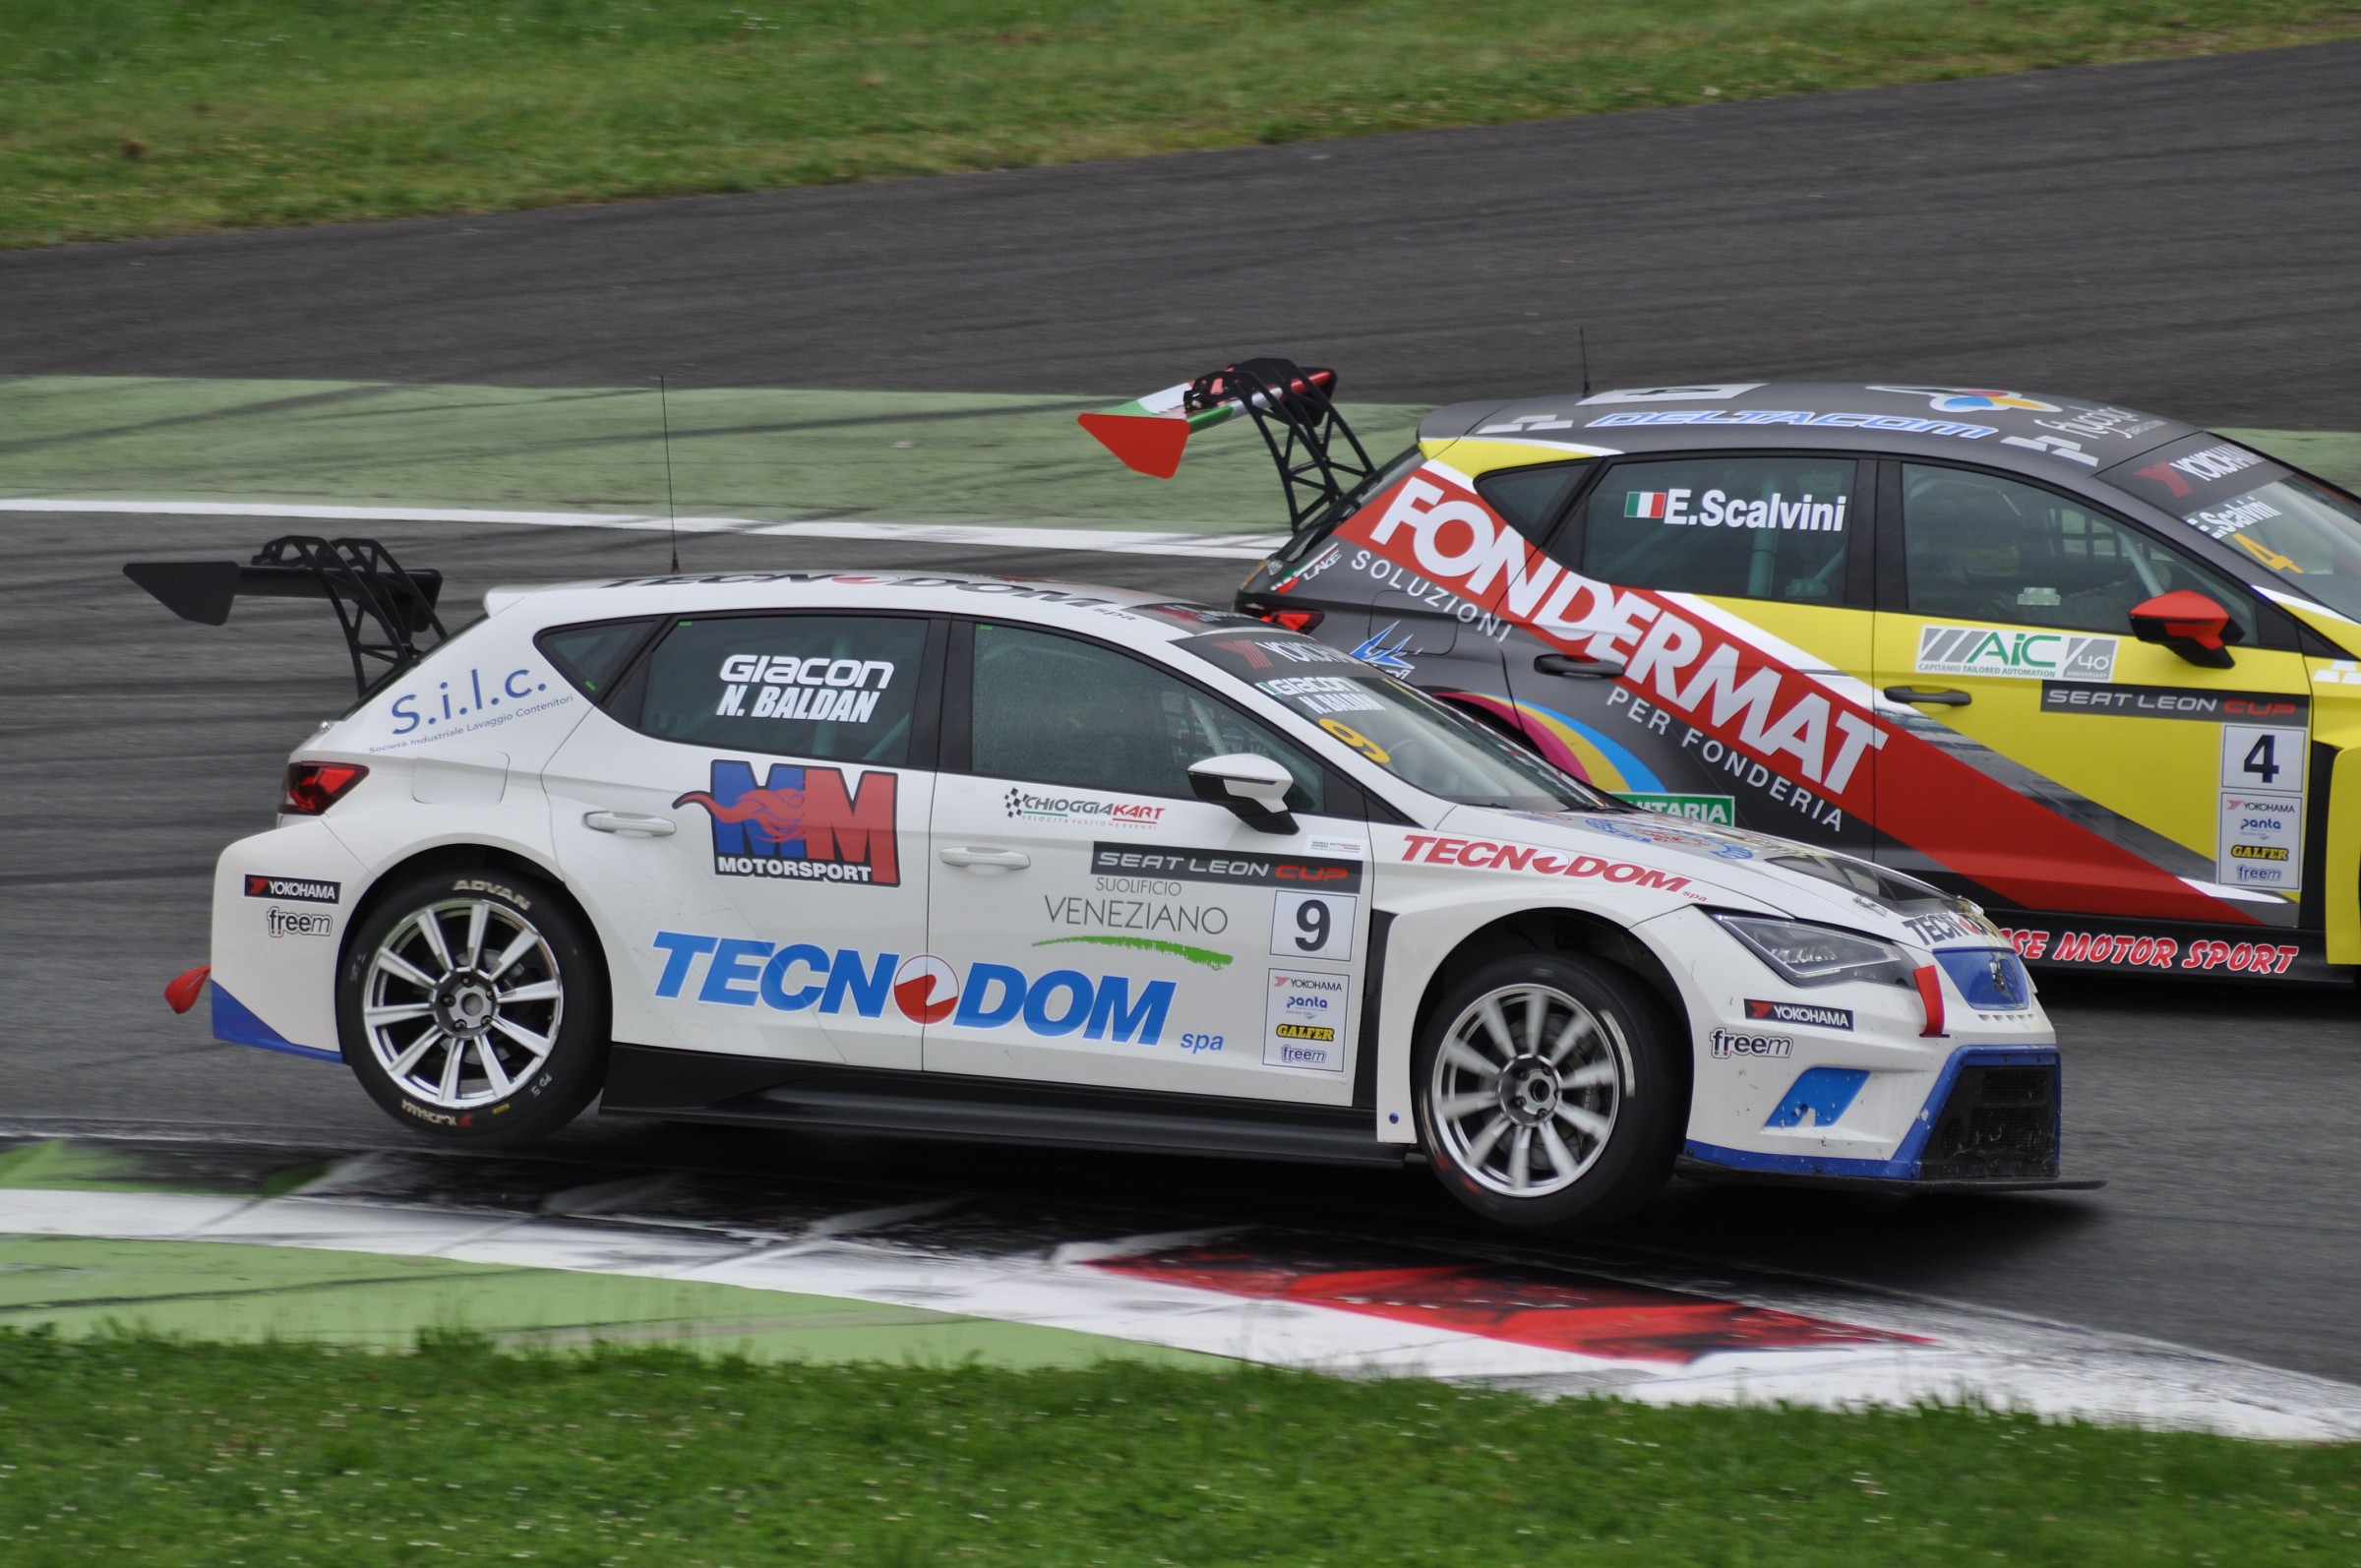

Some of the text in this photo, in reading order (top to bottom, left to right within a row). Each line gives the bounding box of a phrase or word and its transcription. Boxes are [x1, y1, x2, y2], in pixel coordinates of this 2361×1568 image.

[1664, 488, 1847, 532] E.Scalvini
[2231, 532, 2305, 574] 4
[1352, 550, 1513, 643] SOLUZIONI
[1093, 607, 1136, 621] spa
[1369, 476, 1890, 795] FONDERMAT
[1918, 663, 2056, 678] CAPITANIO TAILORED AUTOMATION
[715, 685, 881, 723] N. BALDAN
[2047, 689, 2297, 716] SEAT LEON CUP
[410, 726, 464, 746] Industriale
[466, 713, 514, 732] Lavaggio
[515, 694, 575, 718] Contenitori
[1318, 718, 1391, 763] 9
[1606, 685, 1843, 832] PER FONDERIA
[2243, 734, 2280, 784] 4
[2243, 802, 2296, 814] YOKOHAMA
[2240, 818, 2281, 830] panta
[2231, 845, 2289, 861] GALFER
[717, 857, 872, 882] MOTORSPORT
[1097, 852, 1349, 882] SEAT LEON CUP
[2237, 865, 2281, 881] freem
[269, 880, 336, 900] YOKOHAMA
[453, 879, 532, 911] ADVAN
[1095, 876, 1182, 896] SUOLIFICIO
[1682, 890, 1708, 902] spa
[268, 907, 333, 936] freem
[1044, 893, 1229, 935] VENEZIANO
[1294, 899, 1331, 952] 9
[2052, 932, 2177, 969] MOTOR
[2182, 938, 2299, 975] SPORT
[1290, 978, 1343, 992] YOKOHAMA
[1287, 995, 1328, 1009] panta
[1774, 1005, 1849, 1027] YOKOHAMA
[1180, 1030, 1225, 1055] spa
[1277, 1024, 1334, 1041] GALFER
[1711, 1028, 1792, 1058] freem
[1282, 1045, 1326, 1062] freem
